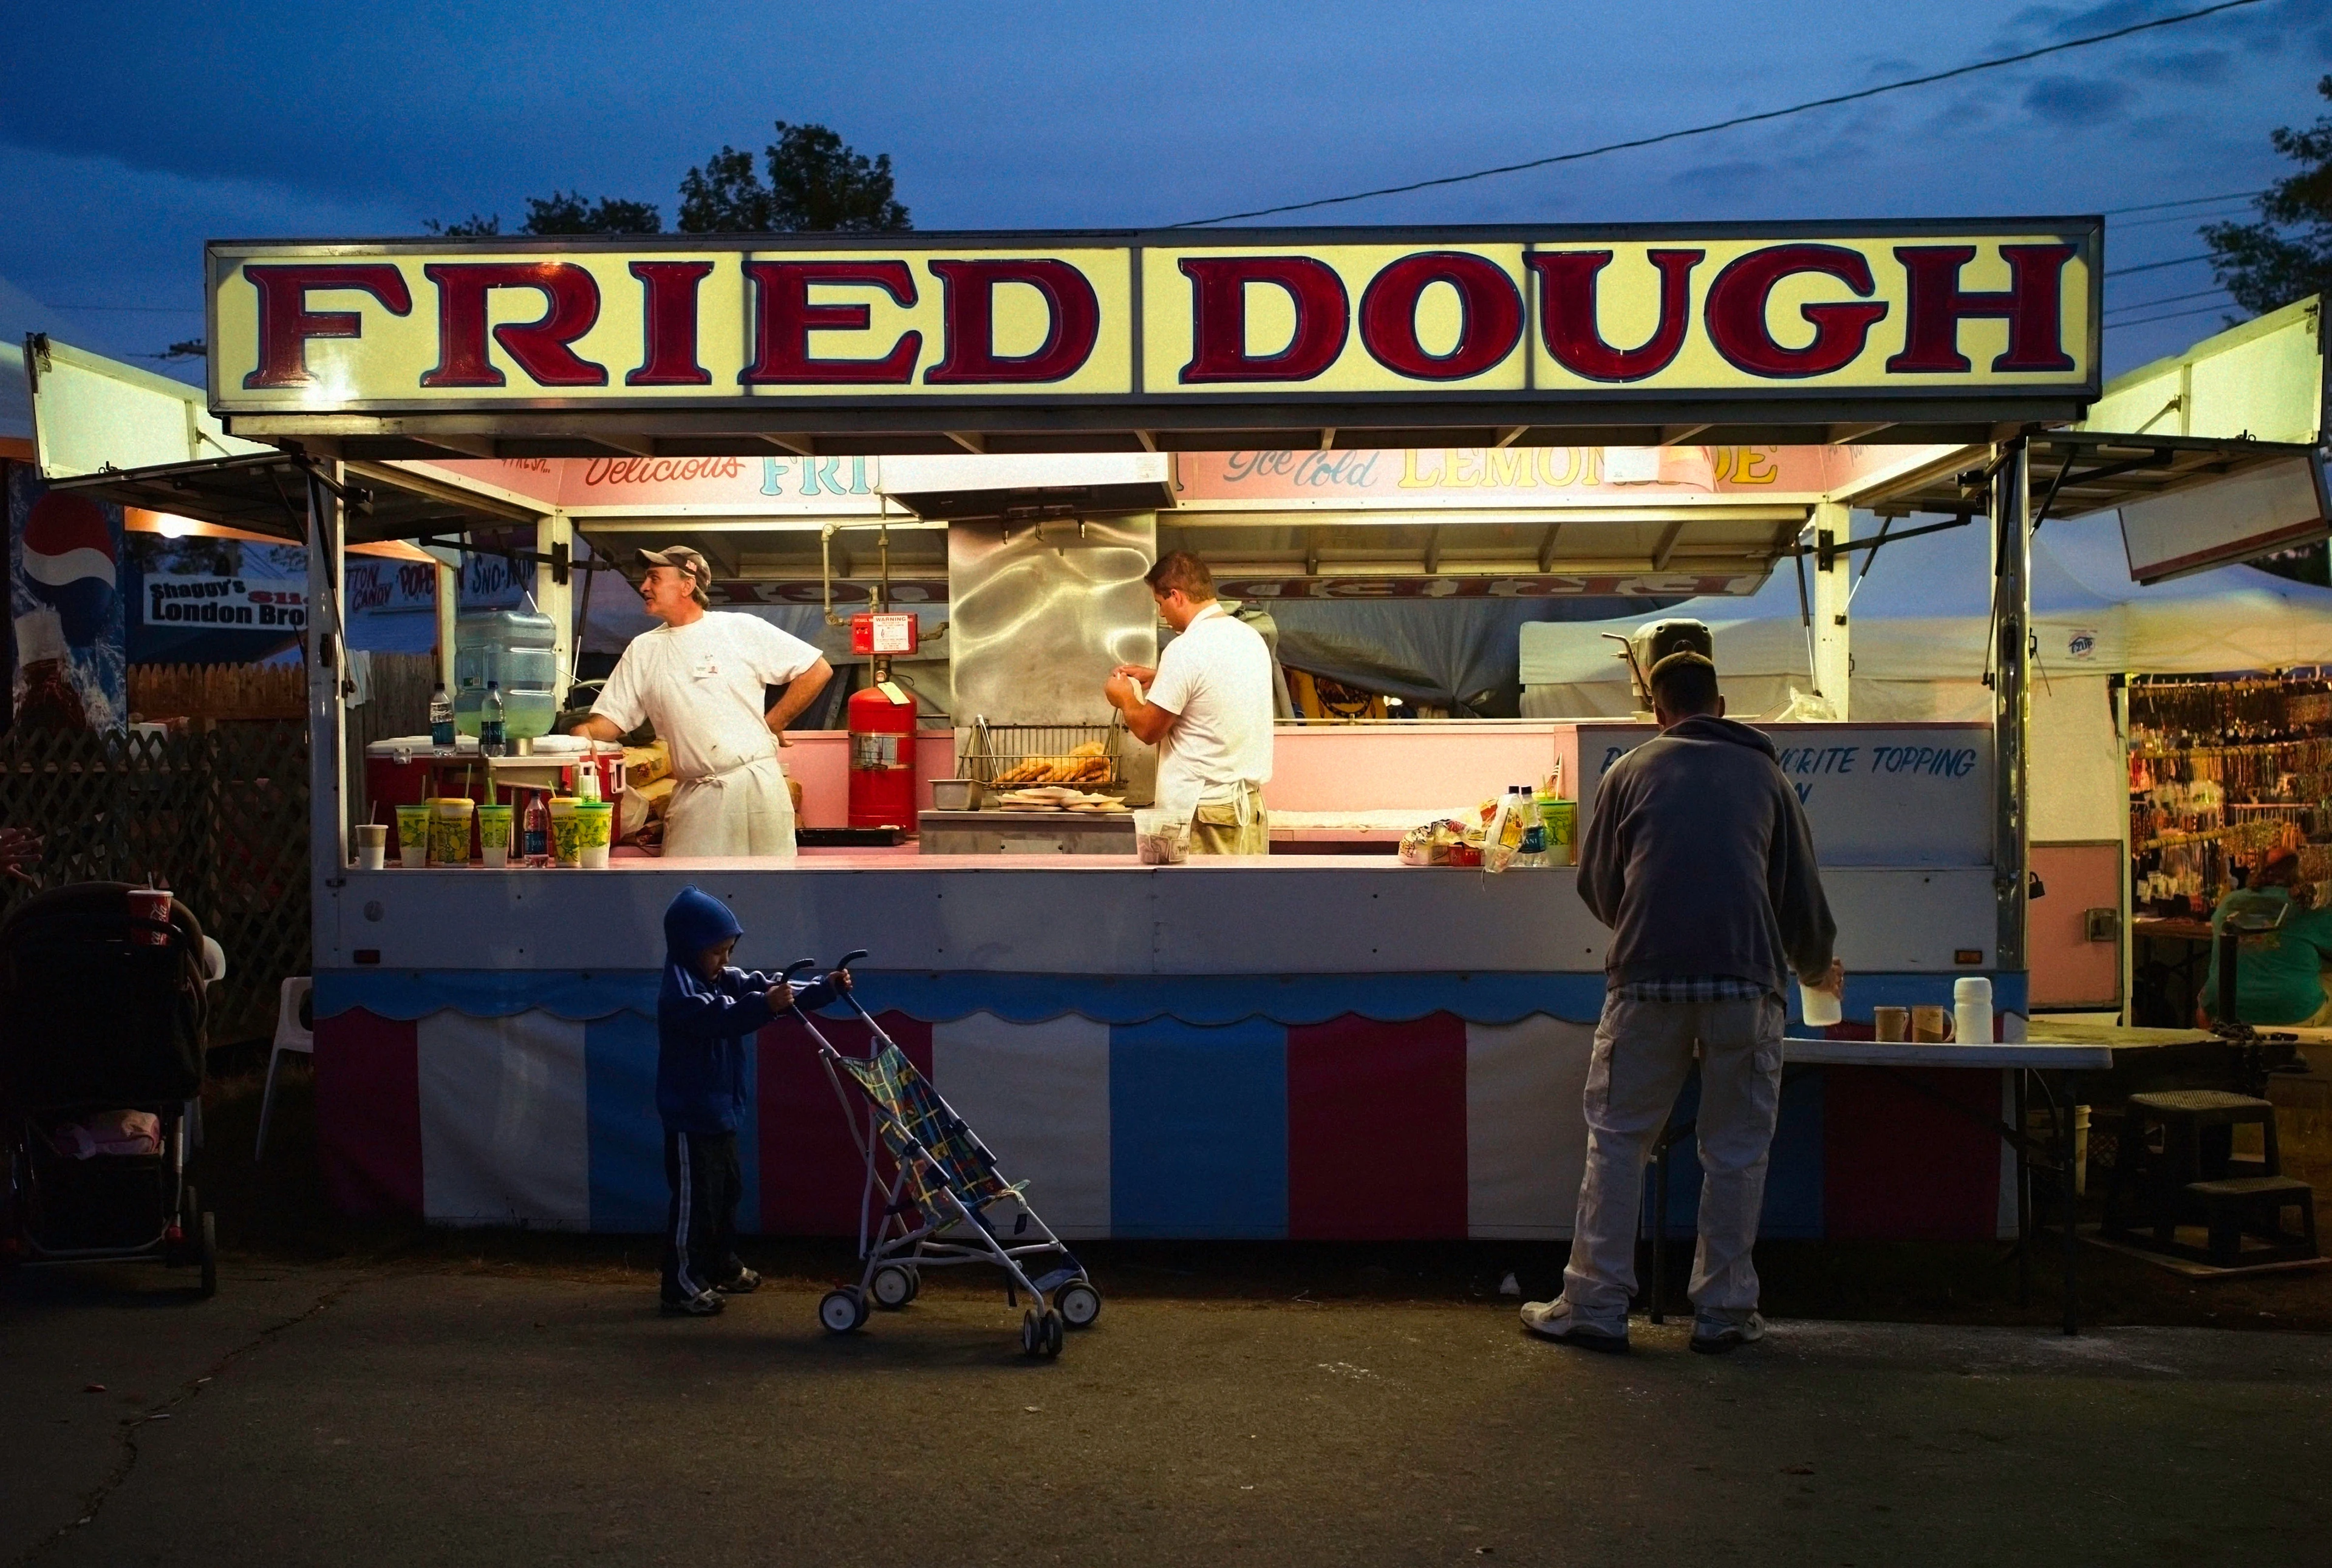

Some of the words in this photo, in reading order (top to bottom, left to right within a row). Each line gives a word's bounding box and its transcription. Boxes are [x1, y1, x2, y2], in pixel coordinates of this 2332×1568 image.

[244, 258, 1100, 387] FRIED
[1178, 243, 2076, 384] DOUGH
[585, 457, 746, 486] Delicious
[1223, 449, 1296, 482] Ice
[1294, 449, 1380, 488] Cold
[150, 579, 246, 599] Shaggy's
[152, 601, 253, 624] London
[1872, 746, 1977, 778] TOPPING
